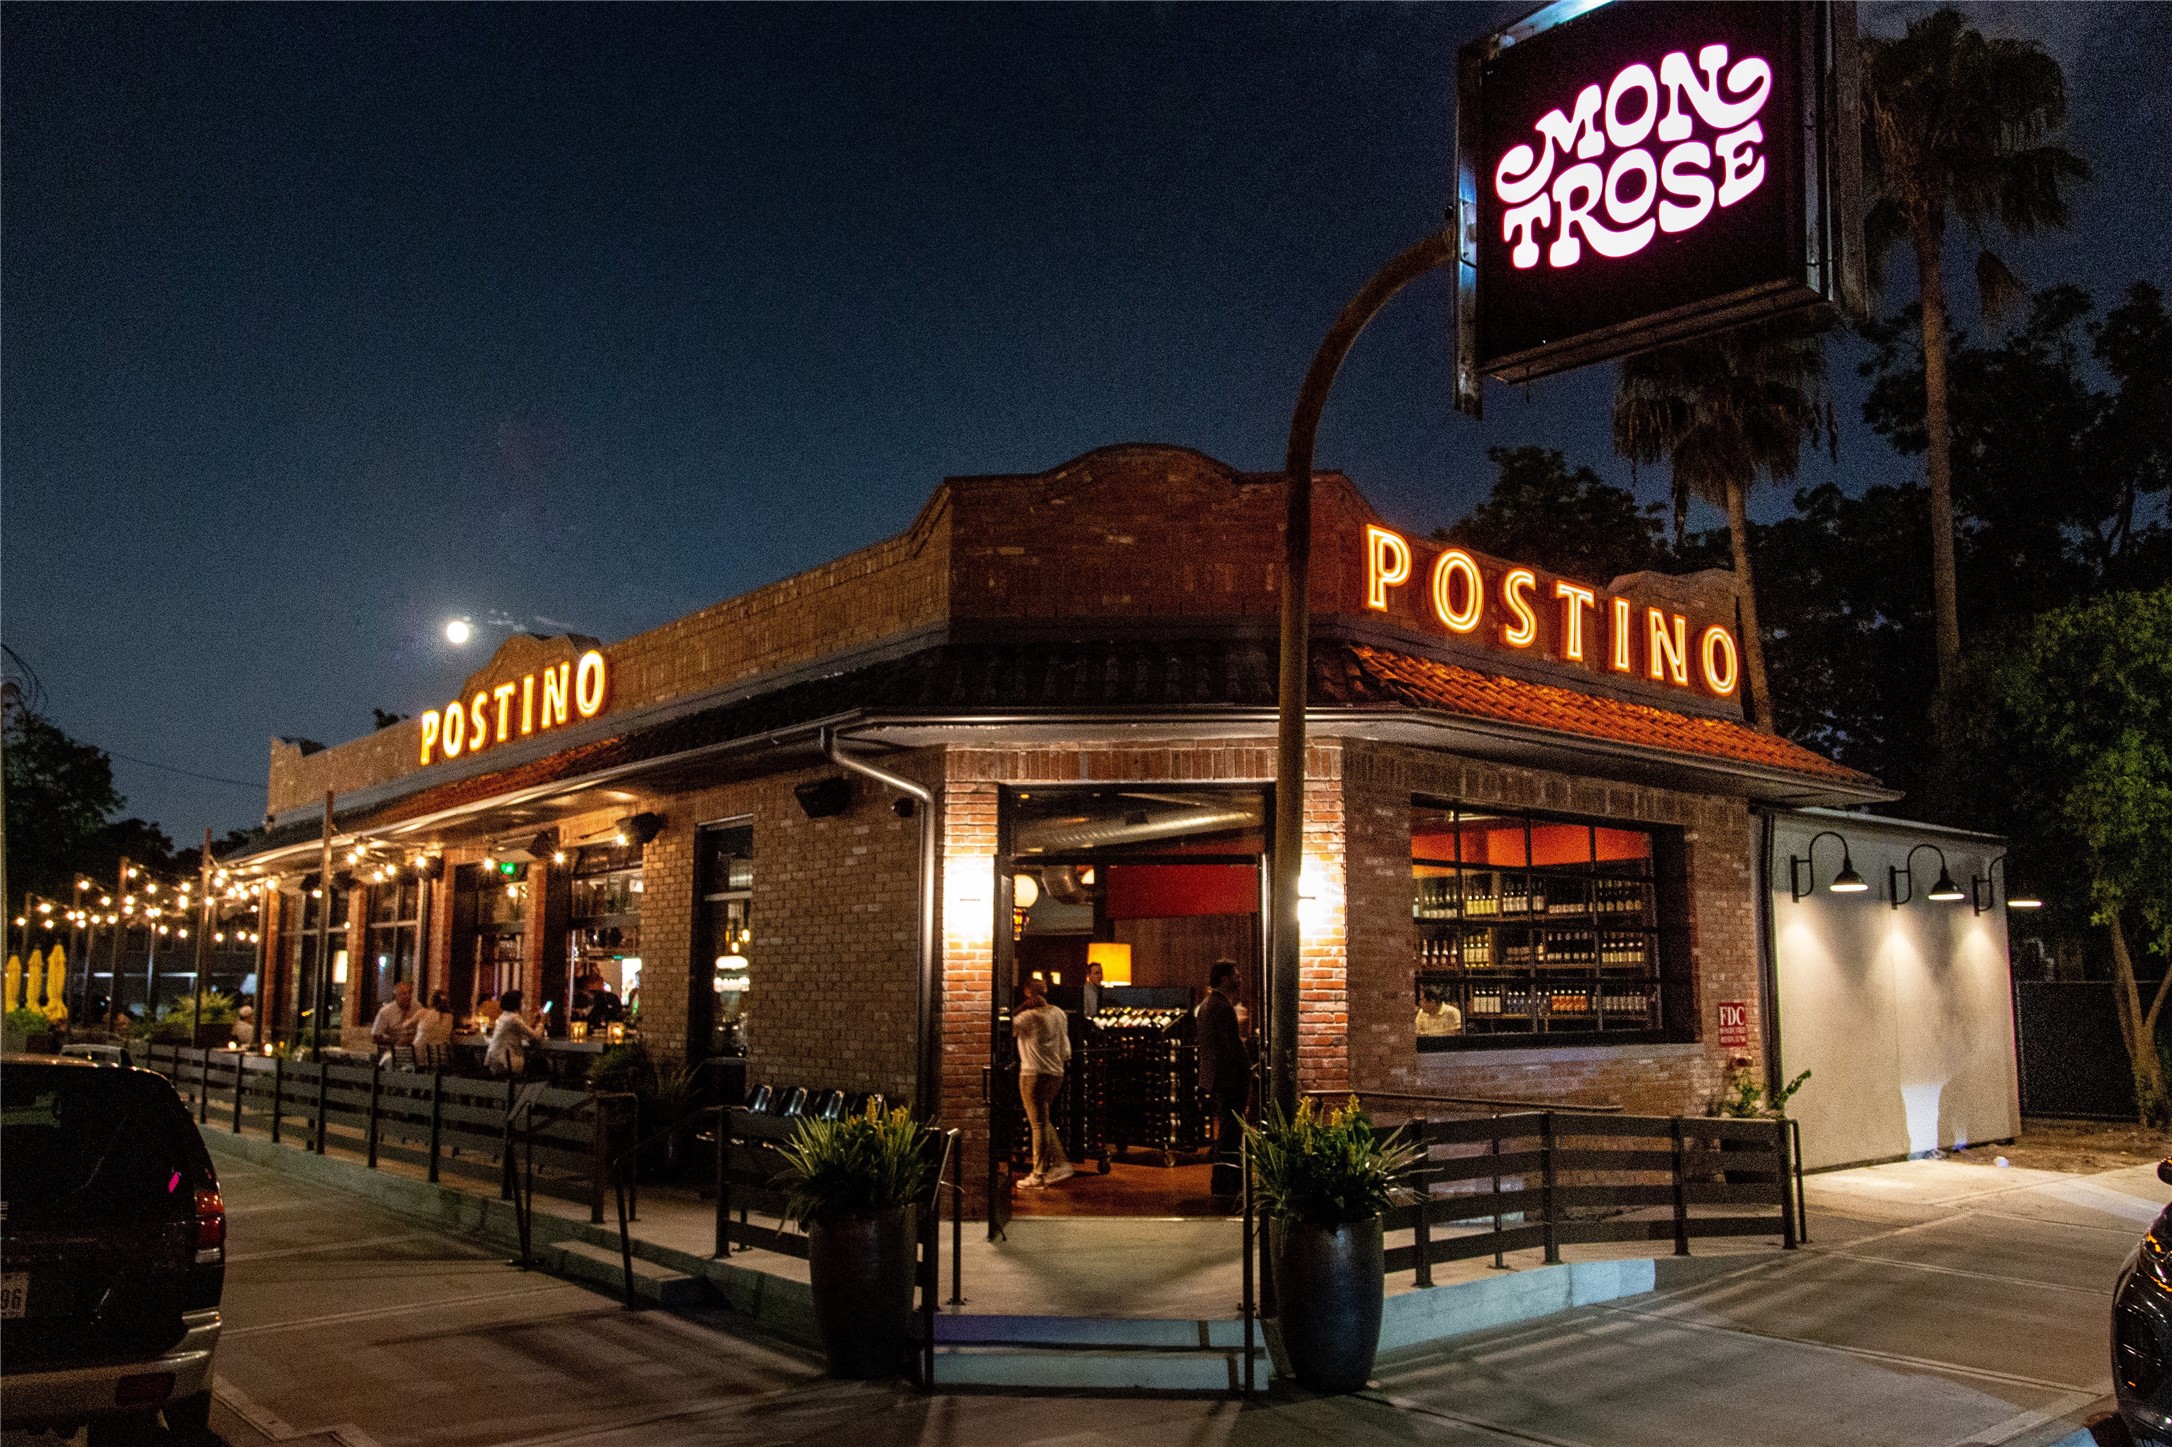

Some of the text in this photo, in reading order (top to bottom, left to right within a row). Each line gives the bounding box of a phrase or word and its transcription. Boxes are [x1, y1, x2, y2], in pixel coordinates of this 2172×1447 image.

[1496, 44, 1771, 204] MON
[1503, 120, 1766, 269] TROSE
[1366, 523, 1739, 697] POSTINO
[420, 650, 605, 766] POSTINO
[1719, 1006, 1745, 1026] FDC
